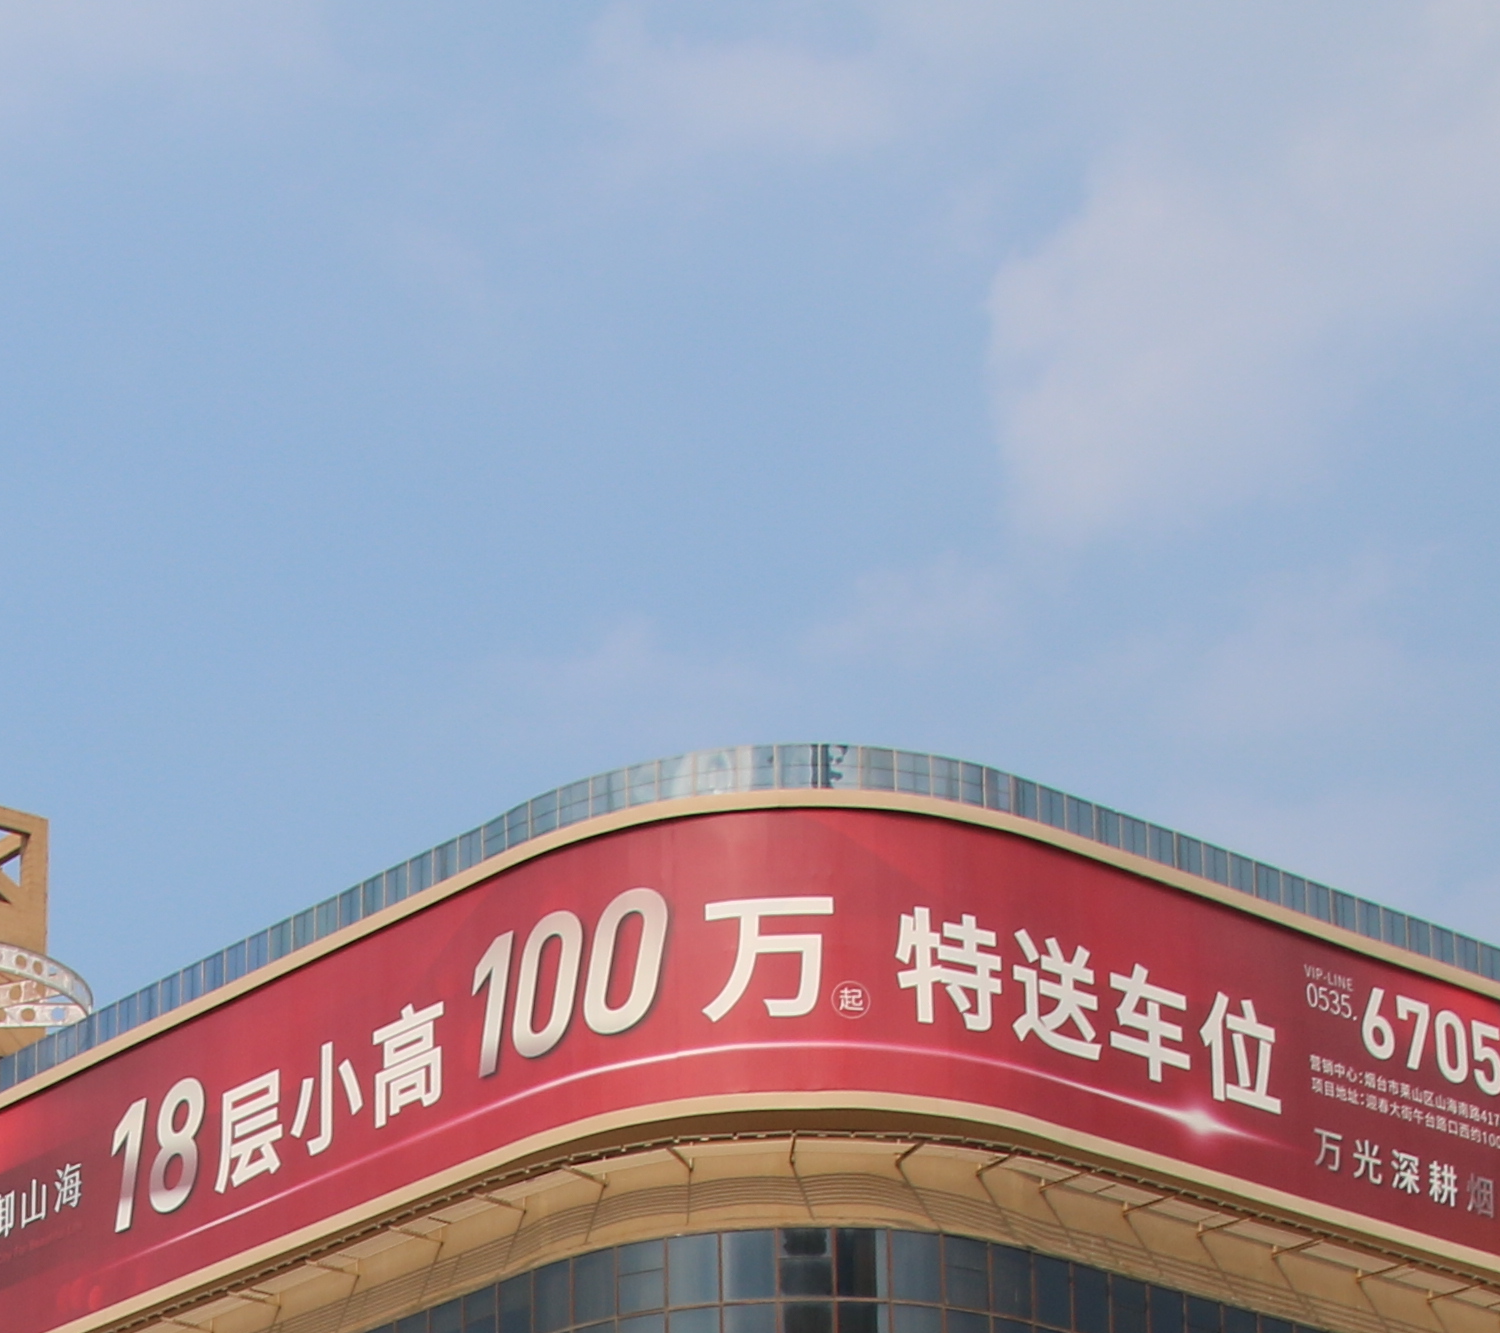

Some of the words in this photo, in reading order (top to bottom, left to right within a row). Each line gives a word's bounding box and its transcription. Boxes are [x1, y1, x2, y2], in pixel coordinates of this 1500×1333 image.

[894, 904, 1282, 1115] 特送车位
[1303, 964, 1354, 993] VIP-LINE
